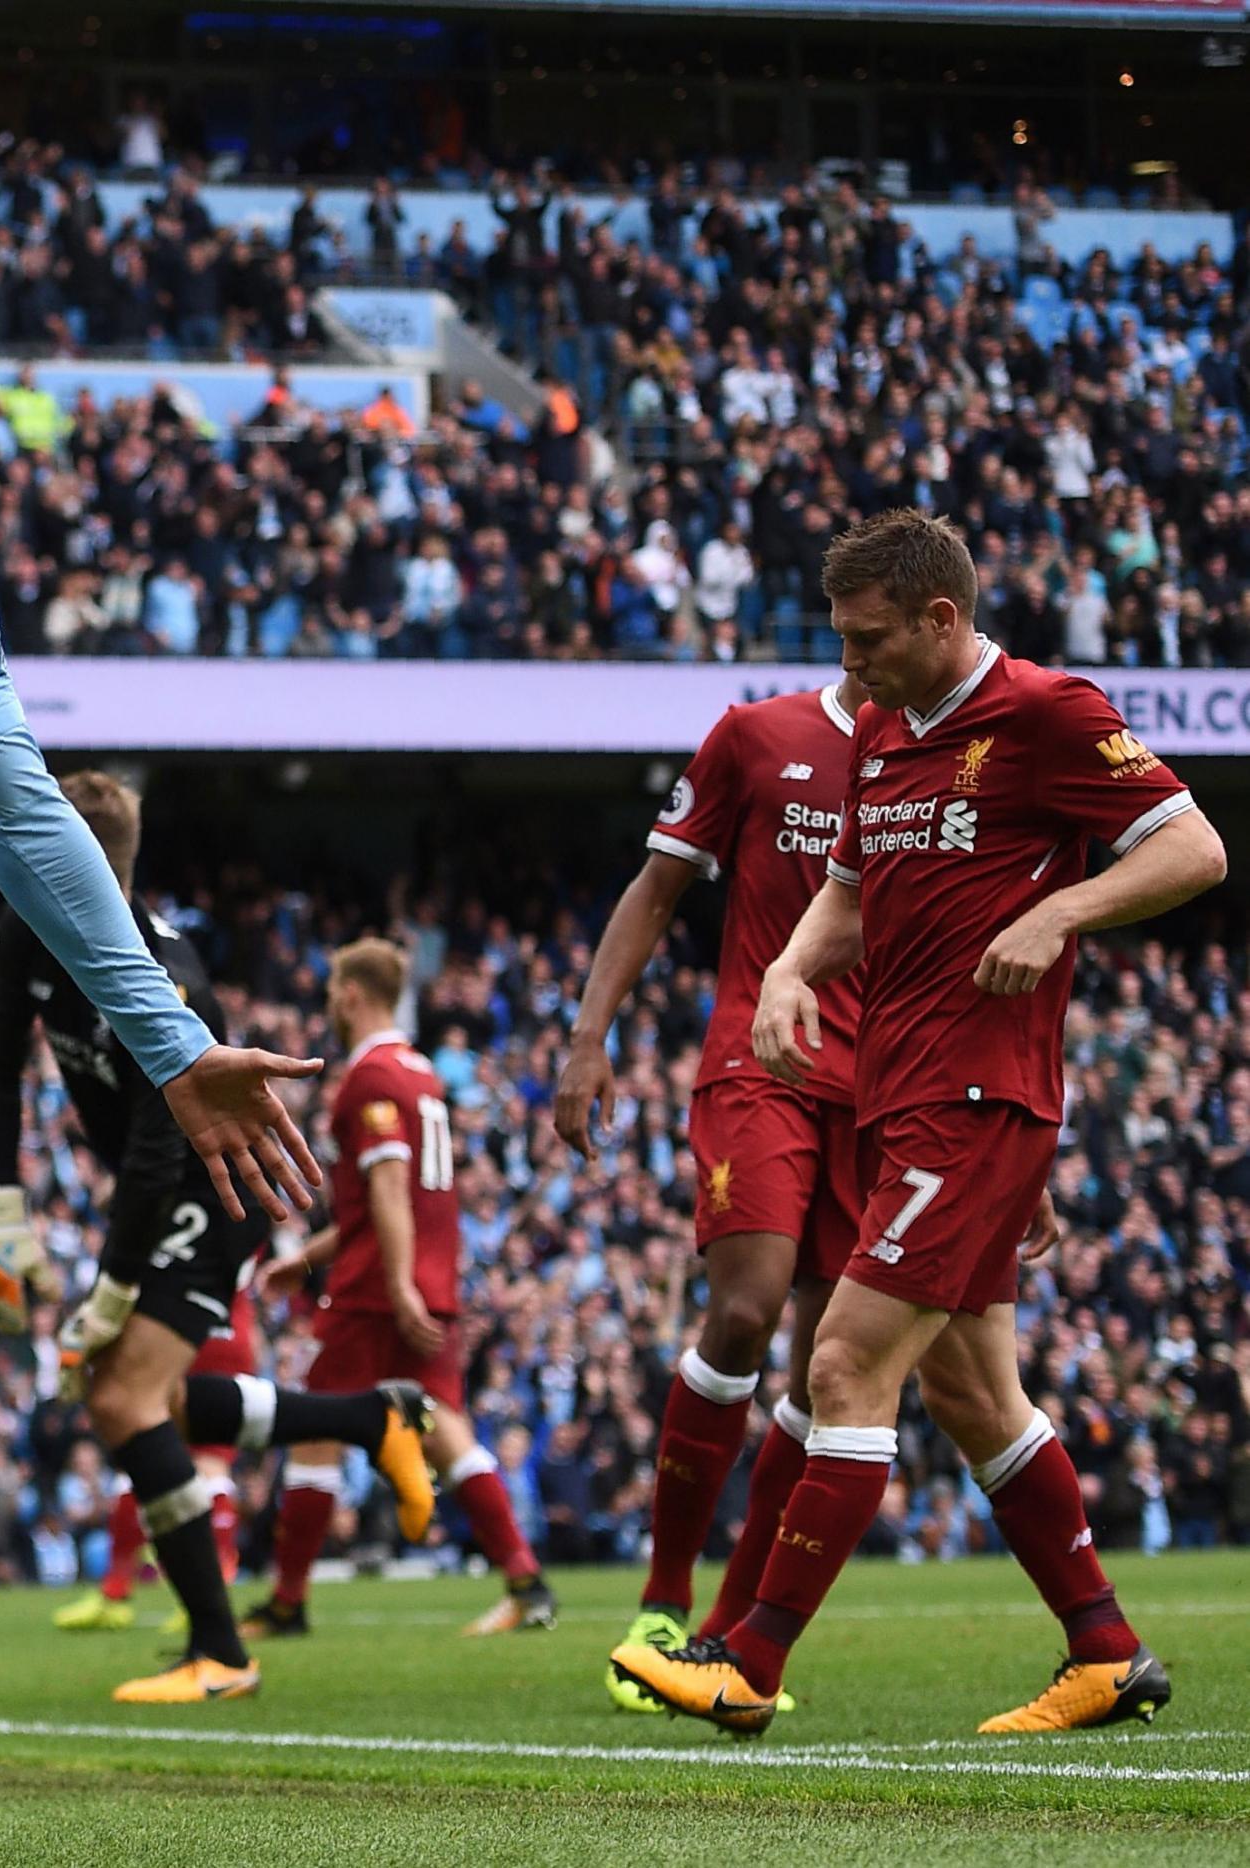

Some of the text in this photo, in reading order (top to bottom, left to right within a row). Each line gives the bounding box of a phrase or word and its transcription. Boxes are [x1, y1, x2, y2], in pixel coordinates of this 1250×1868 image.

[857, 797, 938, 826] Standard
[159, 1202, 209, 1262] 2
[883, 1166, 945, 1241] 7
